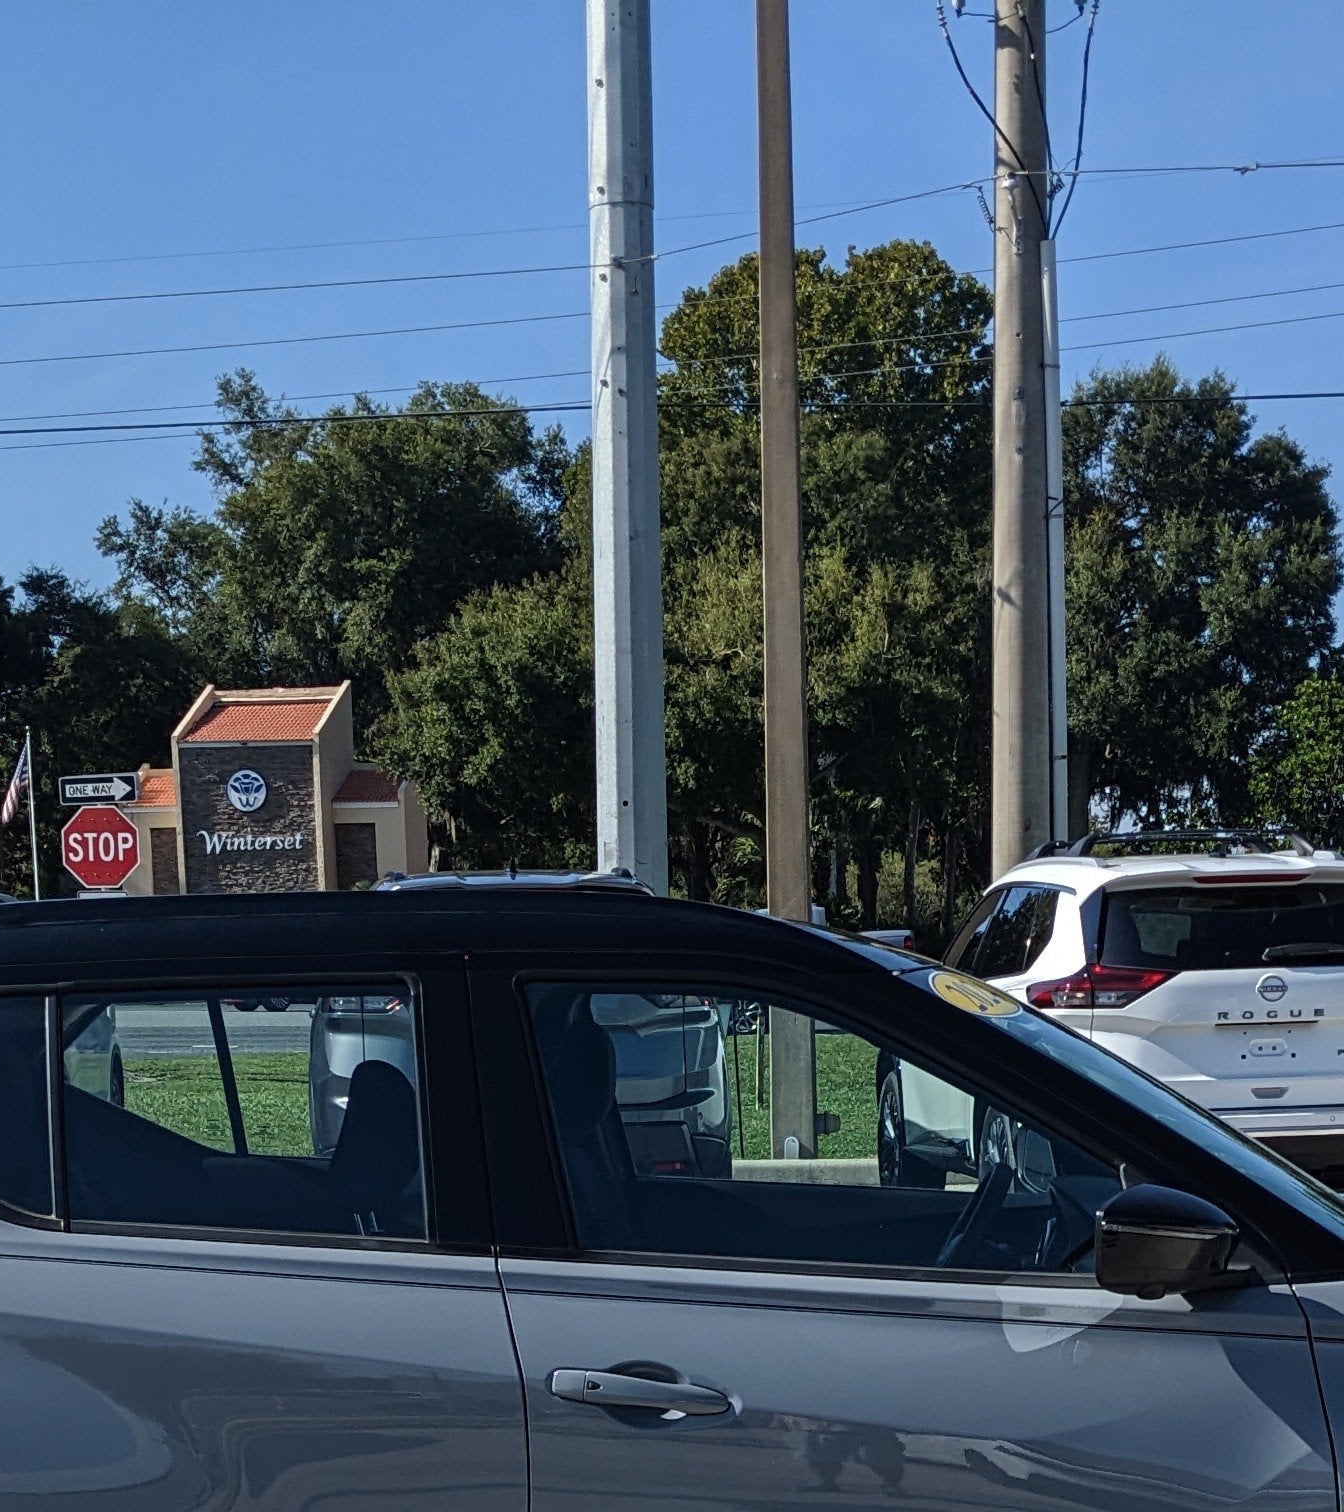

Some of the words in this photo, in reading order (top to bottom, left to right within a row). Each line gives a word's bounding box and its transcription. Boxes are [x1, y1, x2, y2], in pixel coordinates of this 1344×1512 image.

[68, 784, 89, 796] ONE
[92, 783, 113, 795] WAY
[68, 832, 133, 862] STOP
[196, 830, 304, 855] Winterset
[1217, 1008, 1325, 1020] ROGUE
